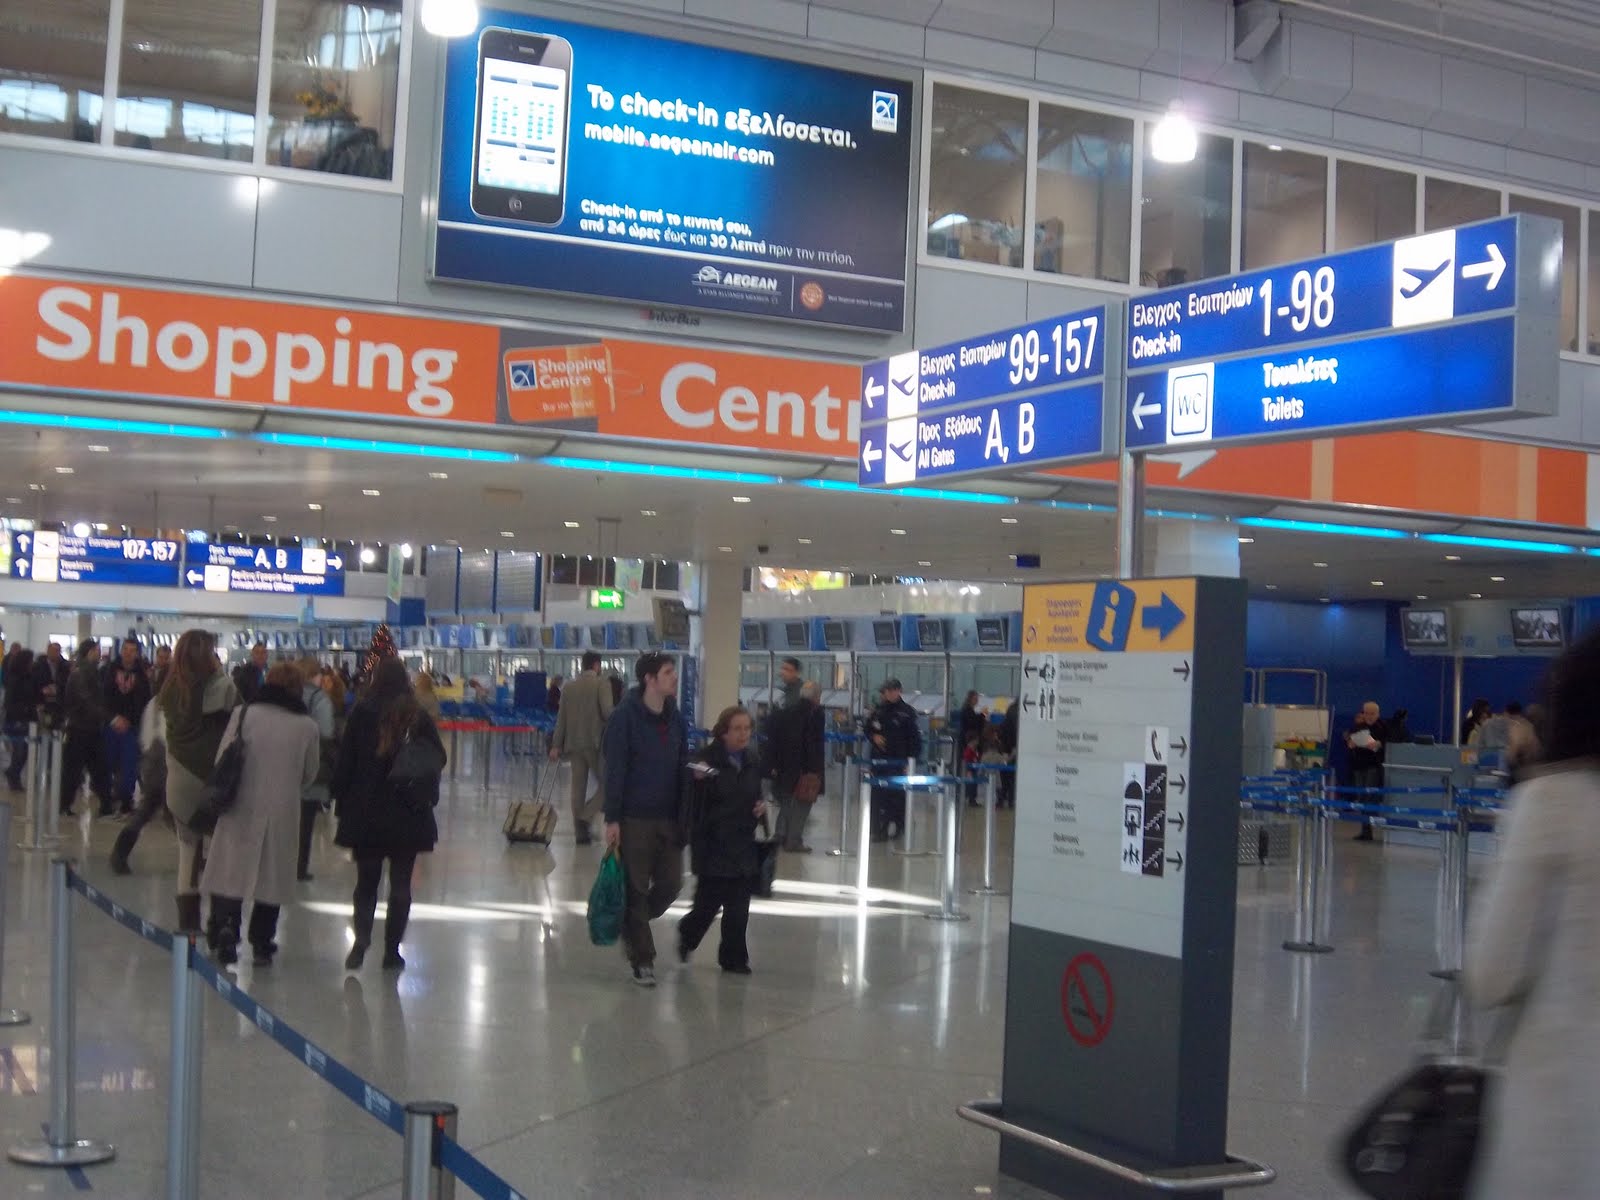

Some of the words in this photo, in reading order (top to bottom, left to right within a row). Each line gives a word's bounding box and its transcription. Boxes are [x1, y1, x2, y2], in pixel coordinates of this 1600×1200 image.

[620, 91, 718, 127] check-in
[725, 108, 857, 149] εξελίσσεται.
[585, 123, 774, 166] mobile.aegeanair.com
[581, 199, 637, 219] Check-in
[580, 218, 604, 232] από
[608, 220, 625, 235] 24
[690, 233, 706, 246] και
[710, 234, 727, 248] 30
[769, 244, 792, 258] πριν
[723, 272, 778, 291] AEGEAN
[1260, 266, 1335, 336] 1-98
[36, 286, 458, 417] Shopping
[1009, 316, 1098, 385] 99-157
[1132, 331, 1181, 359] Check-in
[539, 357, 606, 373] Shopping
[540, 374, 591, 389] Centre
[920, 380, 956, 403] Check-in
[1178, 393, 1202, 416] WC
[1262, 397, 1304, 421] Toilets
[919, 422, 941, 442] Προς
[945, 415, 982, 440] Εξόδους
[1018, 402, 1035, 455] B
[918, 450, 929, 469] All
[931, 448, 955, 467] Gates
[122, 539, 177, 561] 107-157
[275, 549, 288, 569] B
